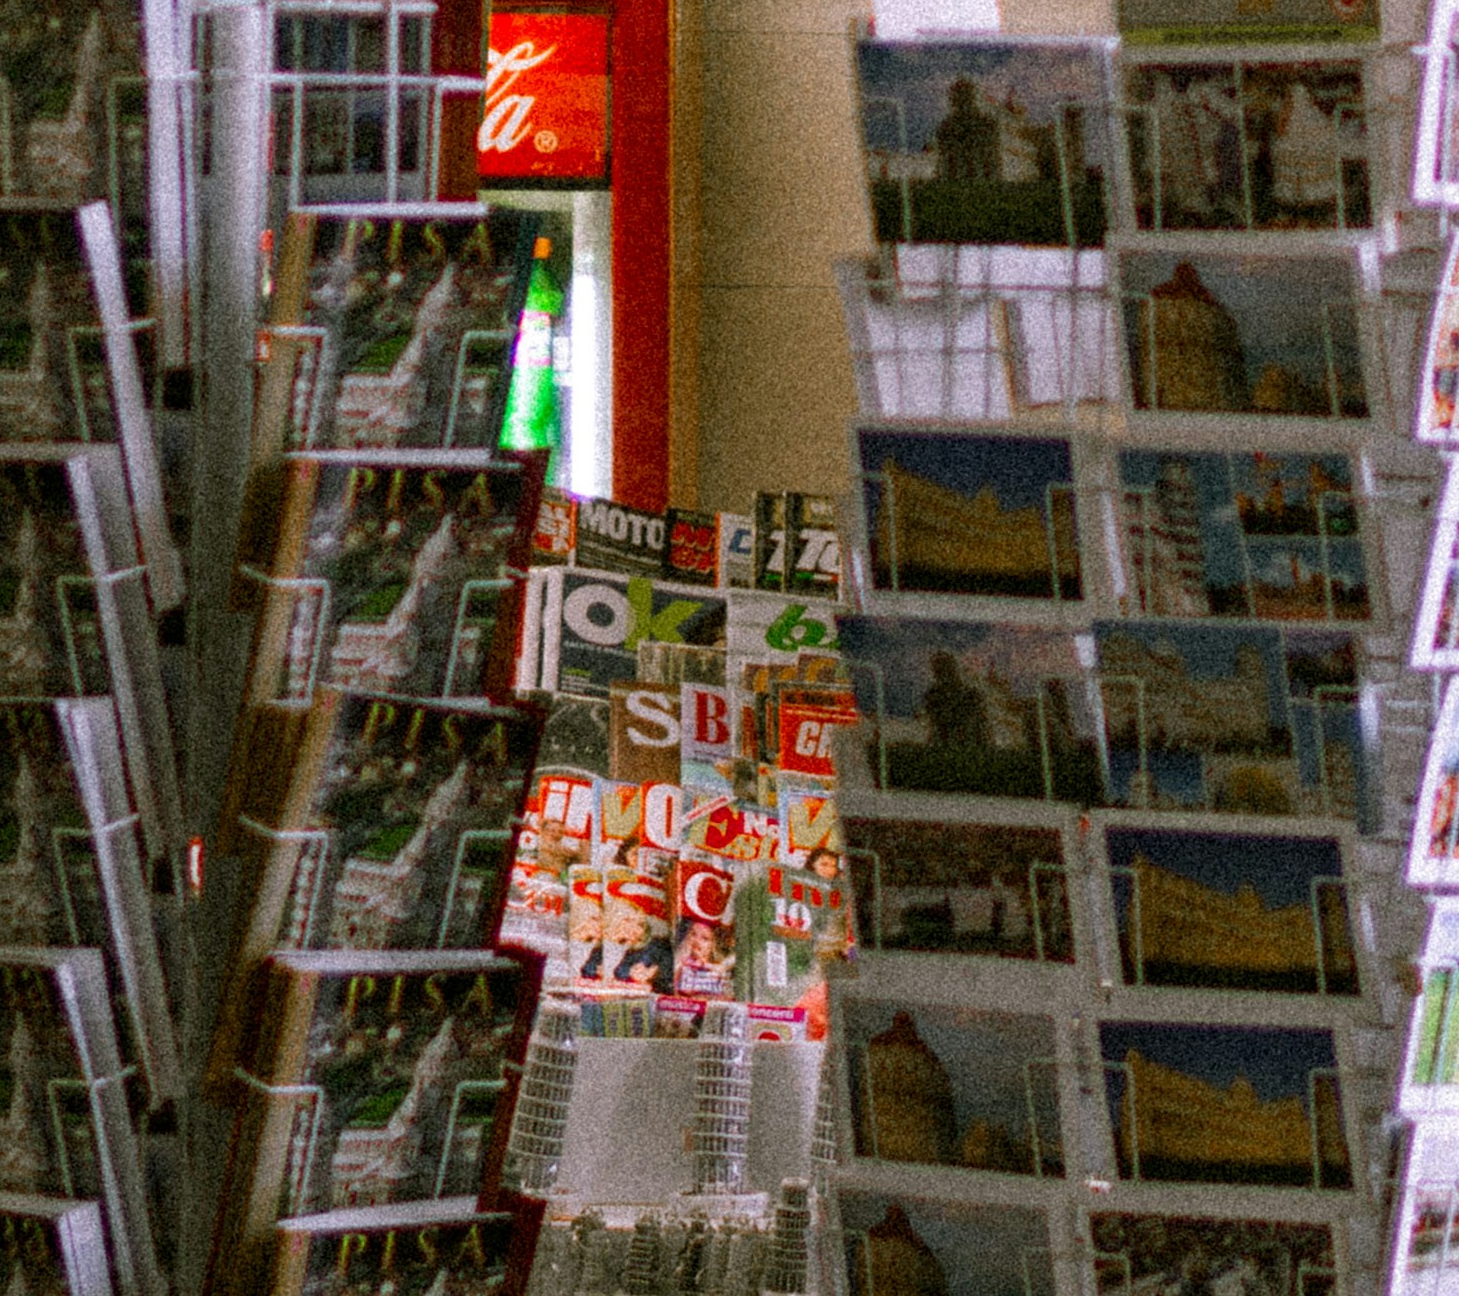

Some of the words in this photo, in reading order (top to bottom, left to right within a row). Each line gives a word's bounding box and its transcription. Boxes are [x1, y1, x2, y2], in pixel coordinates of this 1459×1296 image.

[348, 219, 494, 259] PISA
[348, 467, 494, 507] PISA
[580, 503, 667, 551] MOTO
[365, 702, 510, 763] PISA
[346, 973, 497, 1017] PISA
[339, 1224, 486, 1273] PISA
